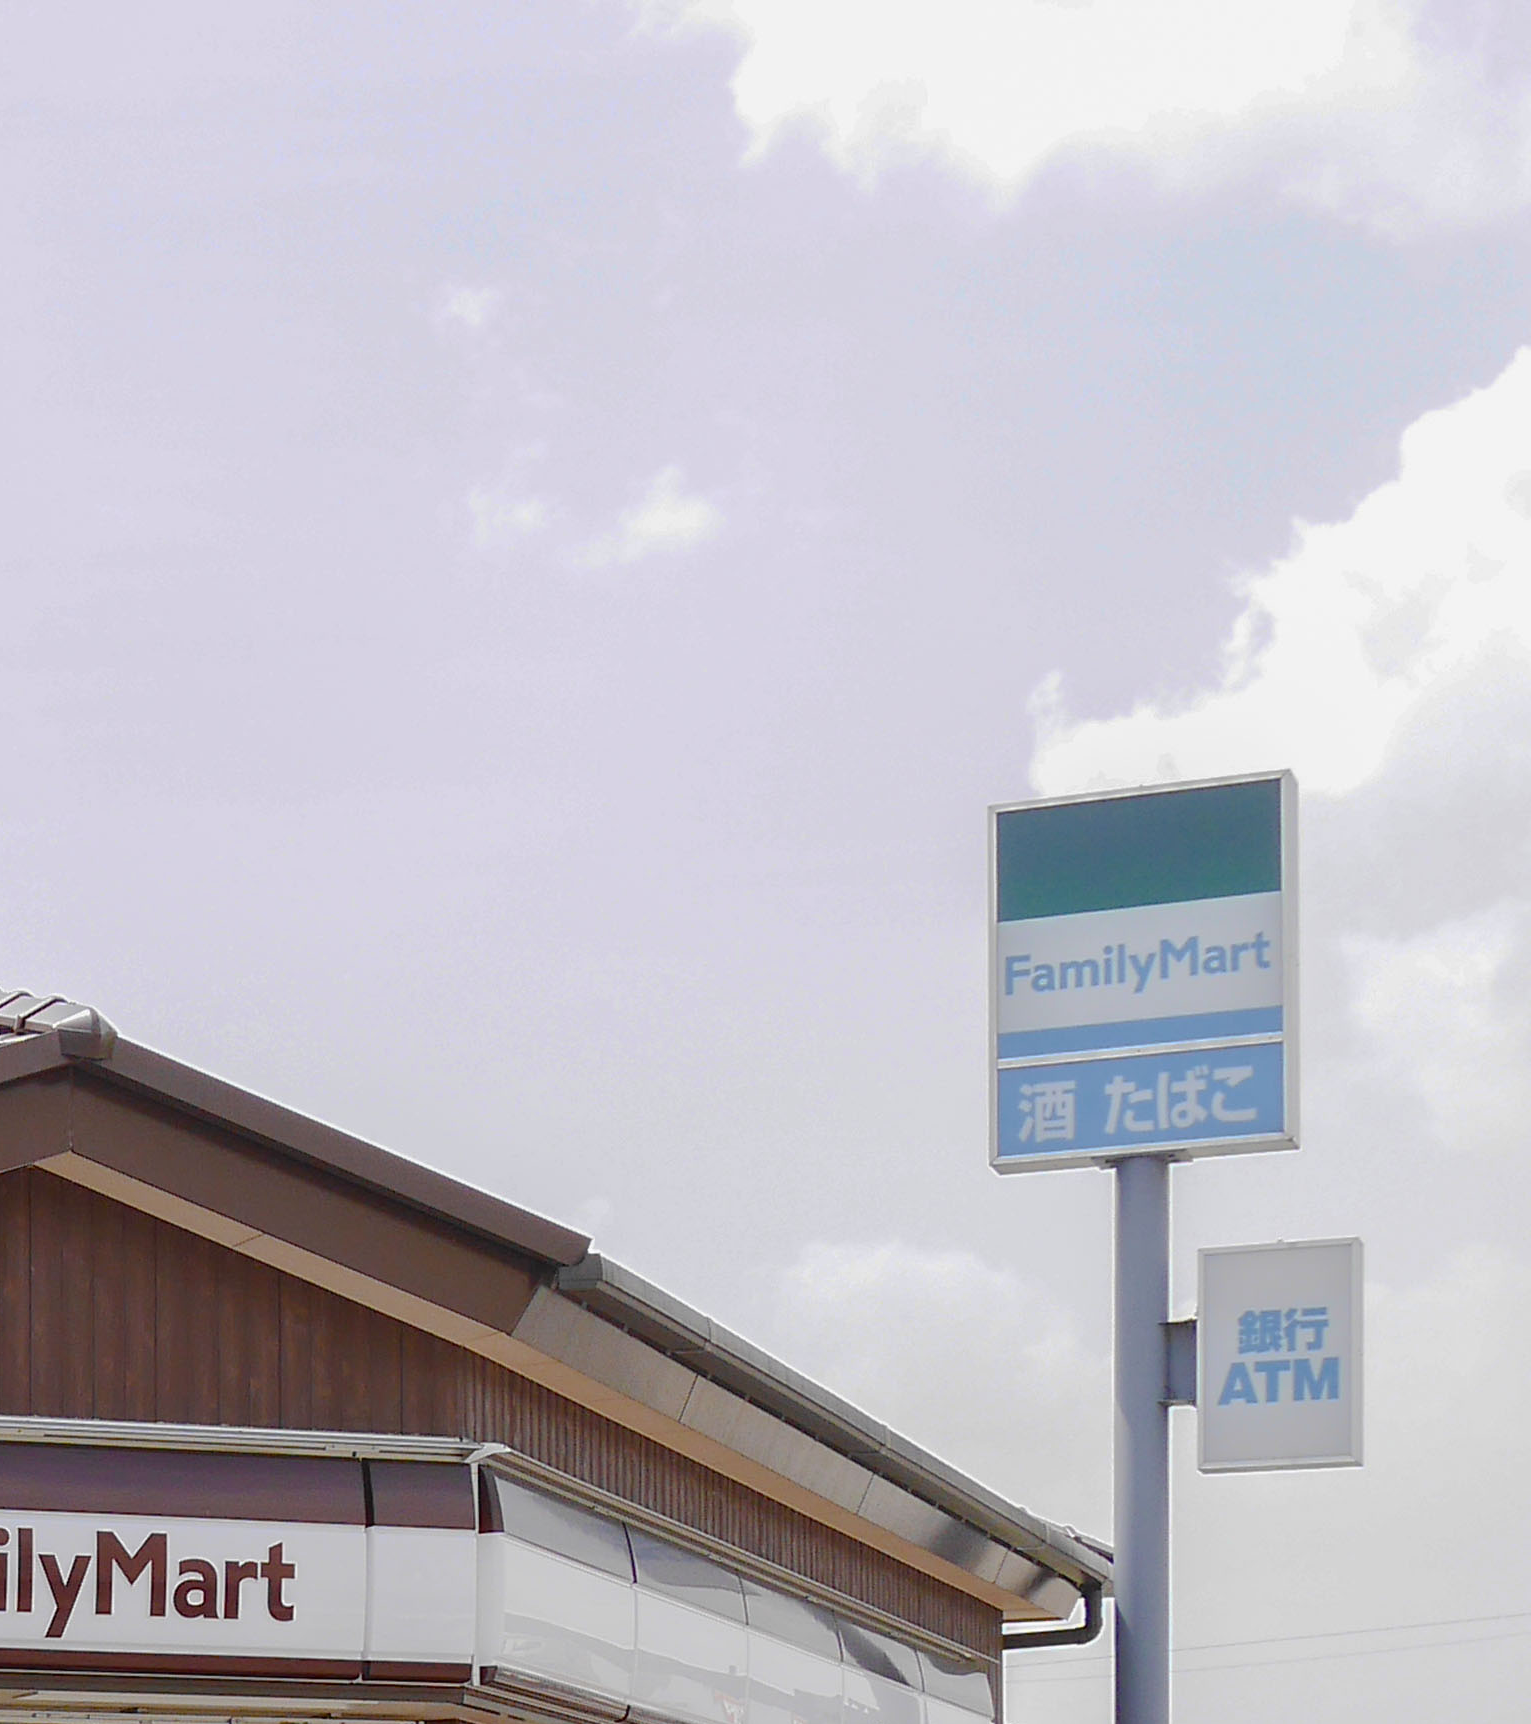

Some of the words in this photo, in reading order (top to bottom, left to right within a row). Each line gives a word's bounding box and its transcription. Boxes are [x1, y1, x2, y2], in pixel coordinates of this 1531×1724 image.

[1004, 931, 1271, 995] FamilyMart
[1018, 1080, 1077, 1143] 酒
[1104, 1065, 1257, 1135] たばこ
[1238, 1307, 1330, 1354] 銀行
[1218, 1357, 1340, 1406] ATM
